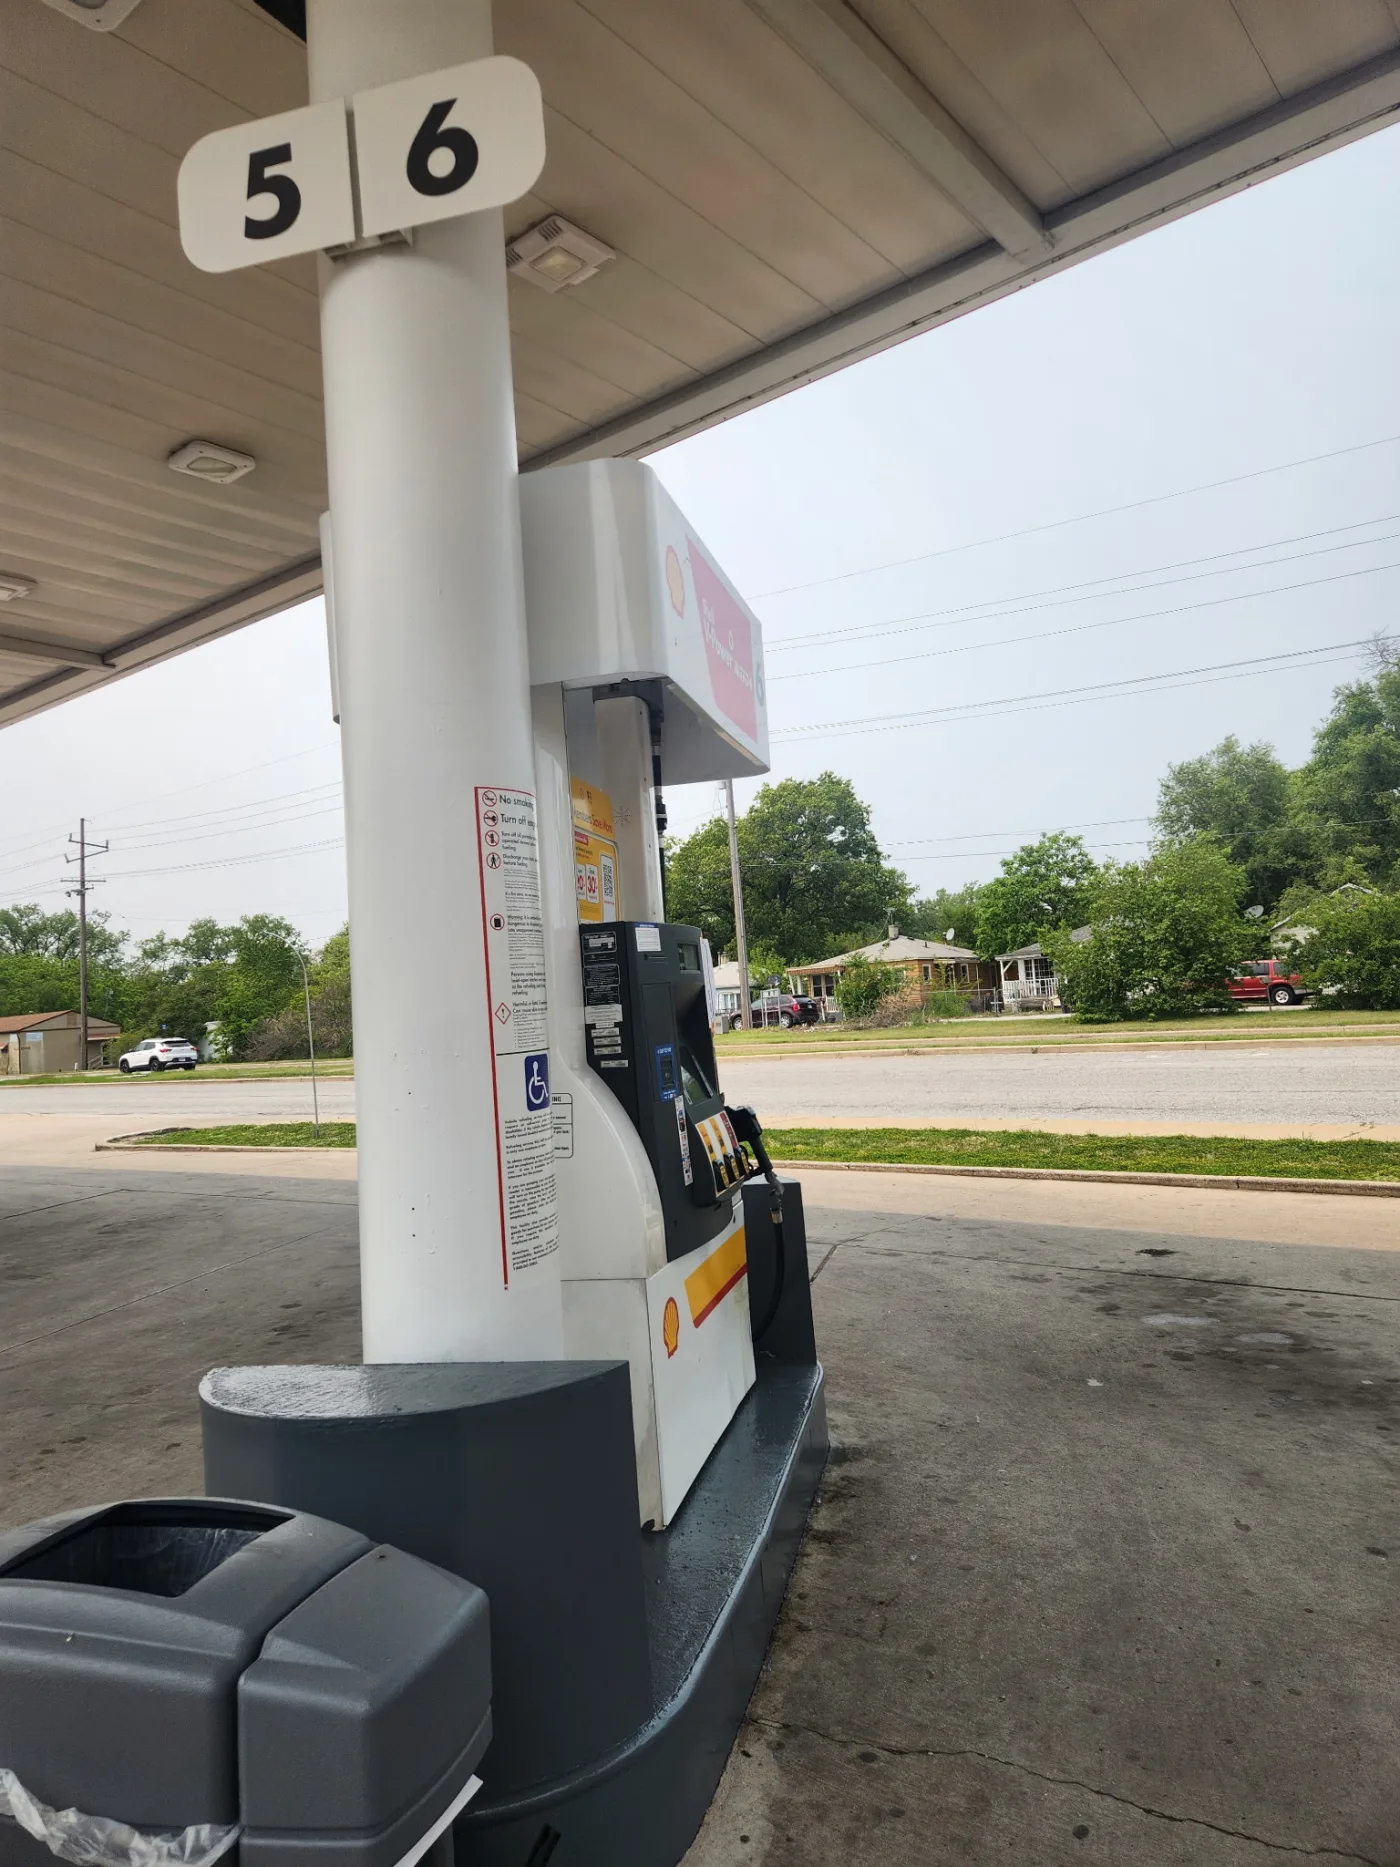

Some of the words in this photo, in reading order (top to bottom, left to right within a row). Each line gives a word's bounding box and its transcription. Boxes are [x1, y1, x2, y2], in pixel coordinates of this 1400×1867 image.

[406, 96, 479, 197] 6
[244, 141, 301, 240] 5
[756, 662, 765, 708] 6
[499, 794, 512, 805] No
[500, 813, 517, 824] Turn
[518, 815, 527, 826] off
